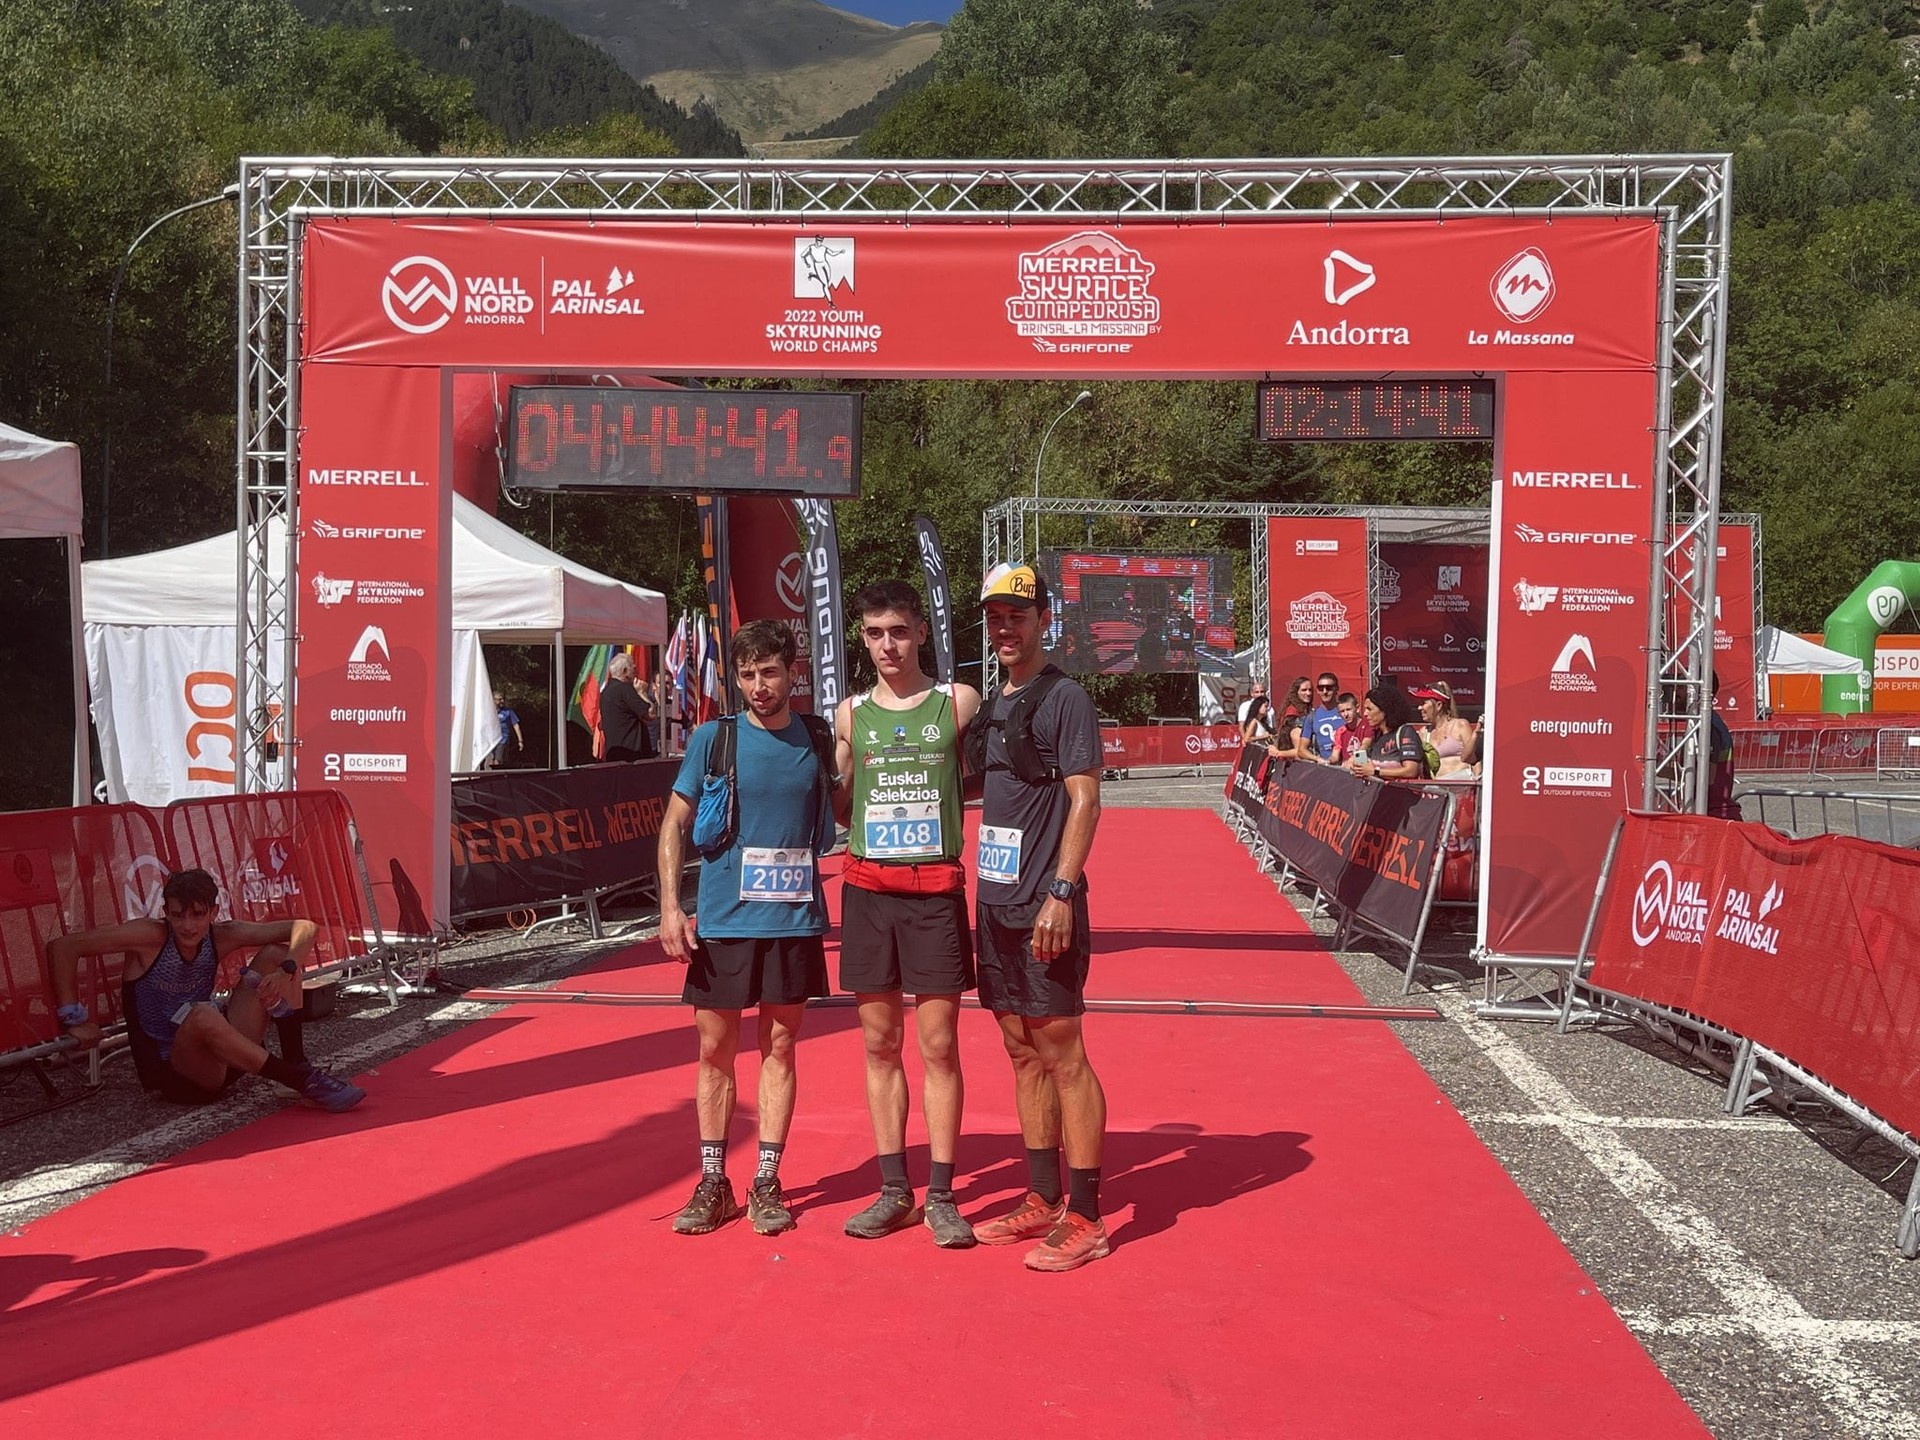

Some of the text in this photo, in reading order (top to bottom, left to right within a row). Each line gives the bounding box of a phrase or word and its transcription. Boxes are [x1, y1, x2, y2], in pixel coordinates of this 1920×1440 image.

[1023, 257, 1145, 274] MERRELL
[464, 277, 526, 295] VALL
[551, 279, 597, 298] PAL
[1022, 275, 1146, 301] SKYRACE
[464, 295, 535, 315] NORD
[549, 298, 645, 316] ARINSAL
[1009, 301, 1158, 321] COMAPEDROSA
[464, 315, 526, 325] ANDORRA
[784, 310, 864, 323] 2022 YOUTH
[765, 324, 882, 340] SKYRUNNING
[1090, 323, 1146, 336] MASSANA
[1149, 324, 1162, 335] BY
[1286, 320, 1412, 346] Andorra
[1467, 330, 1576, 346] La Massana
[770, 340, 878, 353] WORLD CHAMPS
[1059, 343, 1132, 353] GRIFONE
[1265, 385, 1481, 436] 02:14:41
[309, 469, 425, 486] MERRELL
[1512, 471, 1637, 489] MERRELL
[342, 529, 423, 539] GRIFONE
[1547, 532, 1634, 544] GRIFONE
[357, 588, 424, 596] SKYRUNNING
[1562, 595, 1635, 604] SKYRUNNING
[1292, 603, 1342, 611] MERRELL
[1293, 611, 1344, 623] SKYRACE
[349, 758, 402, 767] OCISPORT
[878, 770, 928, 786] Euskal
[1549, 771, 1606, 782] OCISPORT
[870, 787, 939, 802] Selekzioa
[875, 823, 931, 846] 2168
[752, 868, 805, 889] 2199
[1723, 888, 1751, 918] PAL
[1715, 914, 1780, 955] ARINSAL
